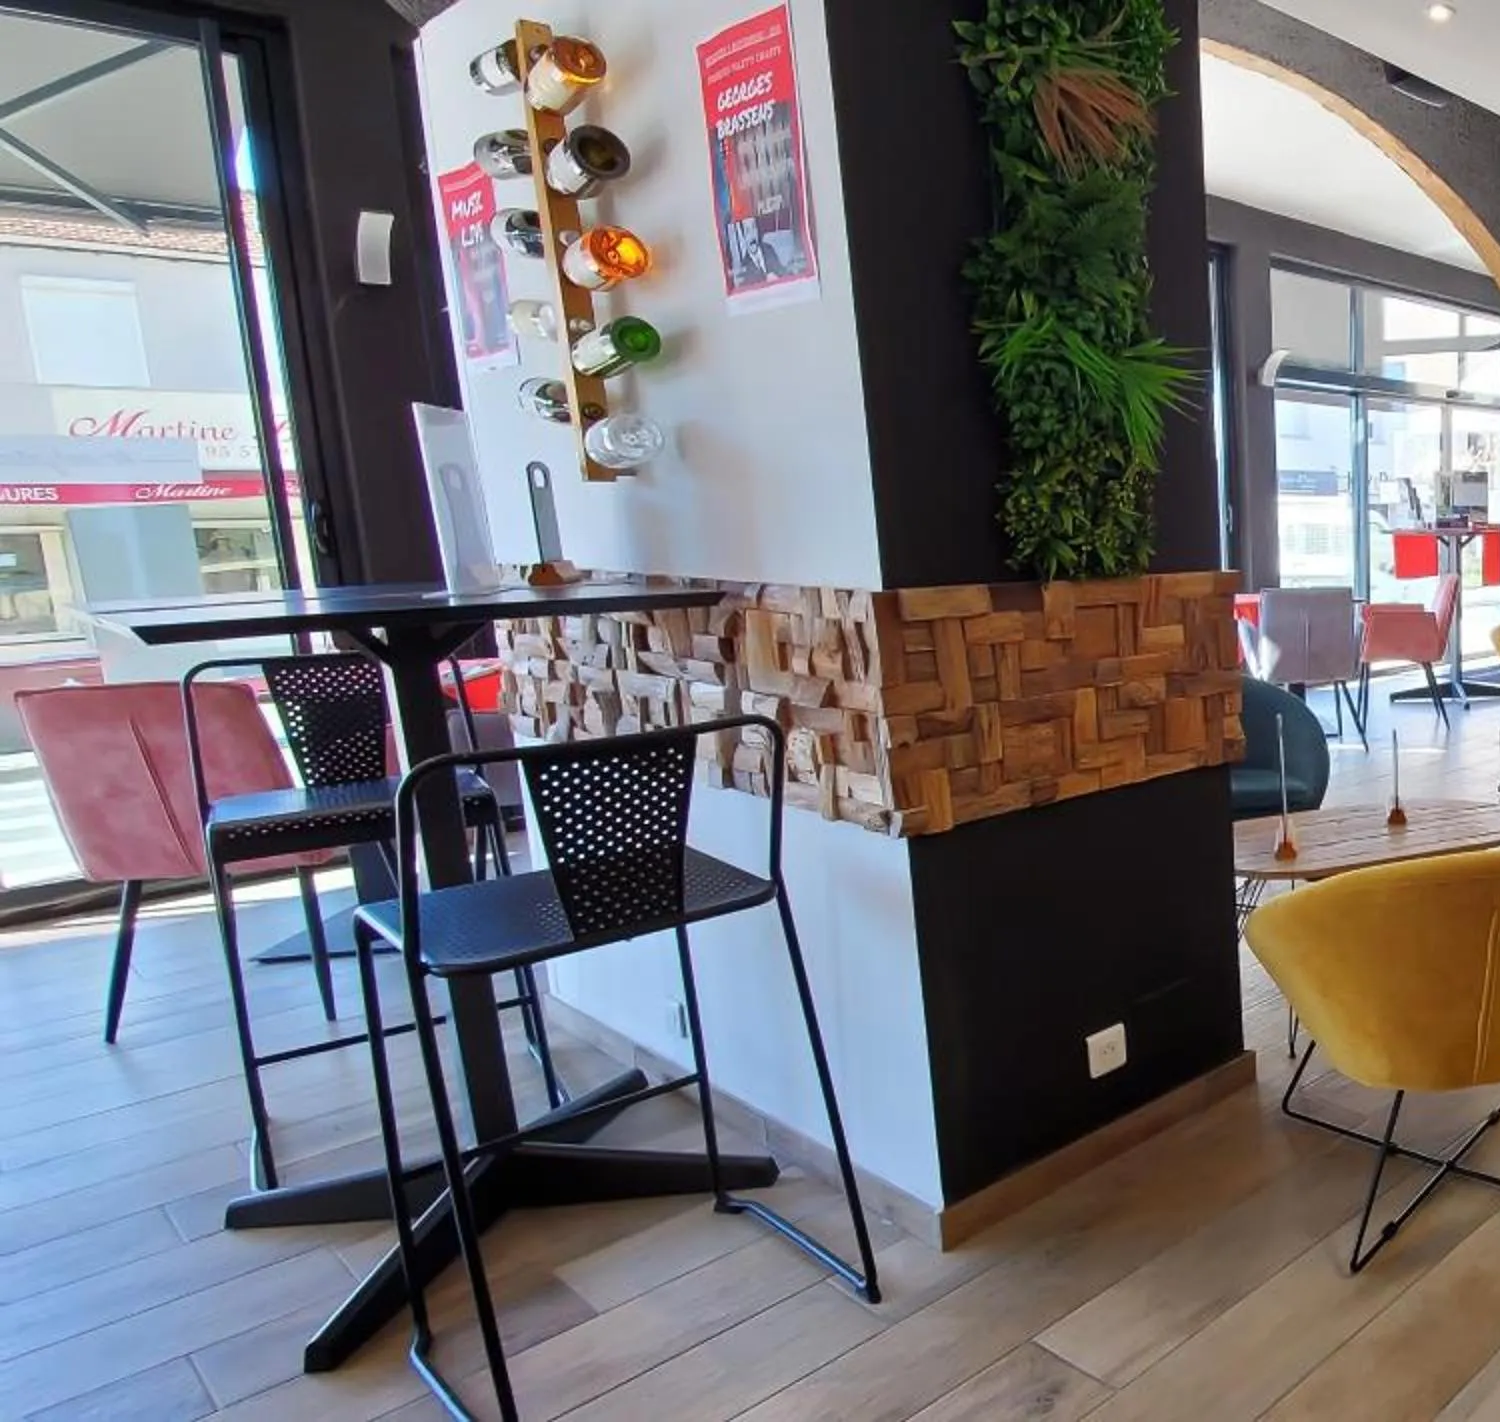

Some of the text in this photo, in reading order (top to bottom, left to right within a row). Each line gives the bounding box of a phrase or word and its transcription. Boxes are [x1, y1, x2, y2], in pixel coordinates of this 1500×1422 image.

[717, 71, 773, 112] GEORGES
[716, 99, 775, 139] BRASSENS
[69, 408, 237, 441] Martine
